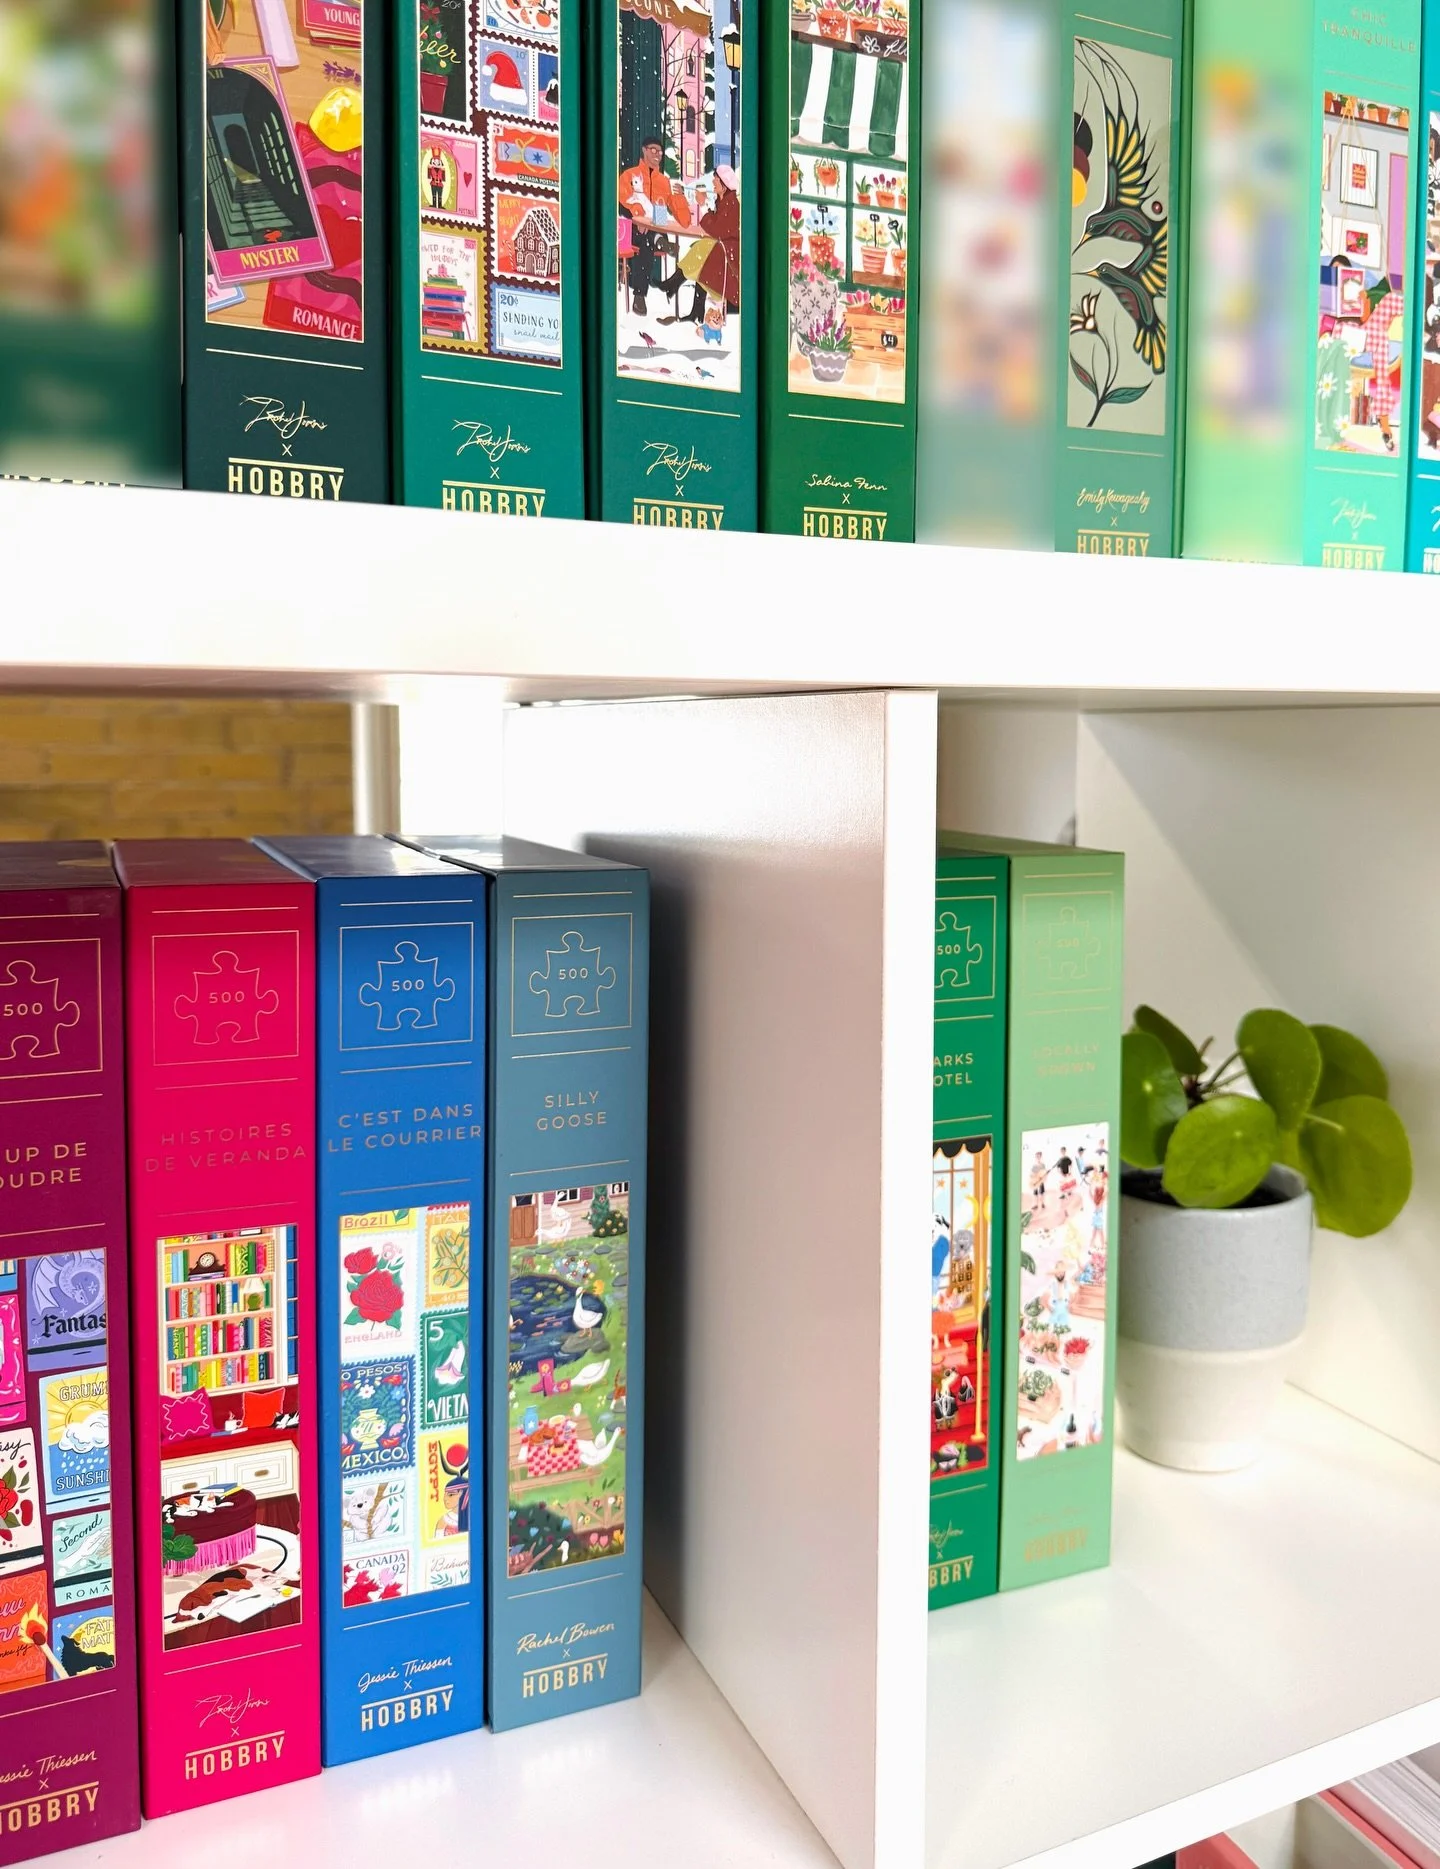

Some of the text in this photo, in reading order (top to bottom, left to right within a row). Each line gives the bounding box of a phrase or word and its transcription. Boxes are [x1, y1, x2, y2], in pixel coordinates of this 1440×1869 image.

[324, 7, 361, 27] YOUNG
[240, 246, 300, 270] MYSTERY
[293, 306, 360, 340] ROMANCE
[503, 312, 545, 328] SENDING
[228, 464, 344, 500] HOBBRY
[805, 473, 887, 491] Sabina Fenn
[443, 487, 546, 518] HOBBRY
[1077, 487, 1106, 513] Emily
[633, 504, 724, 531] HOBBRY
[804, 512, 887, 541] HOBBRY
[1077, 535, 1150, 558] HOBBRY
[1322, 547, 1385, 571] HOBBRY
[937, 944, 961, 956] 500
[559, 967, 588, 981] 500
[391, 979, 425, 993] 500
[3, 1002, 44, 1017] 500
[209, 991, 246, 1005] 500
[544, 1091, 600, 1109] SILLY
[337, 1103, 474, 1130] C'EST DANS
[536, 1111, 608, 1131] GOOSE
[161, 1123, 293, 1146] HISTOIRES
[327, 1125, 482, 1153] LE COURRIER
[5, 1142, 88, 1163] UP DE
[145, 1146, 308, 1173] DE VERANDA
[344, 1214, 388, 1229] Brazil
[344, 1331, 402, 1344] ENGLAND
[429, 1320, 444, 1342] 5
[357, 1364, 403, 1379] PESOS
[428, 1441, 439, 1502] EGYPT
[59, 1514, 103, 1553] Second
[355, 1552, 406, 1570] CANADA
[391, 1562, 406, 1575] 92
[65, 1584, 111, 1600] ROMA
[516, 1622, 614, 1656] Rachel Bowen
[358, 1656, 453, 1694] Jessie Thiessen
[522, 1658, 608, 1699] HOBBRY
[361, 1690, 453, 1733] HOBBRY
[36, 1750, 98, 1776] Thiessen
[185, 1736, 285, 1781] HOBBRY
